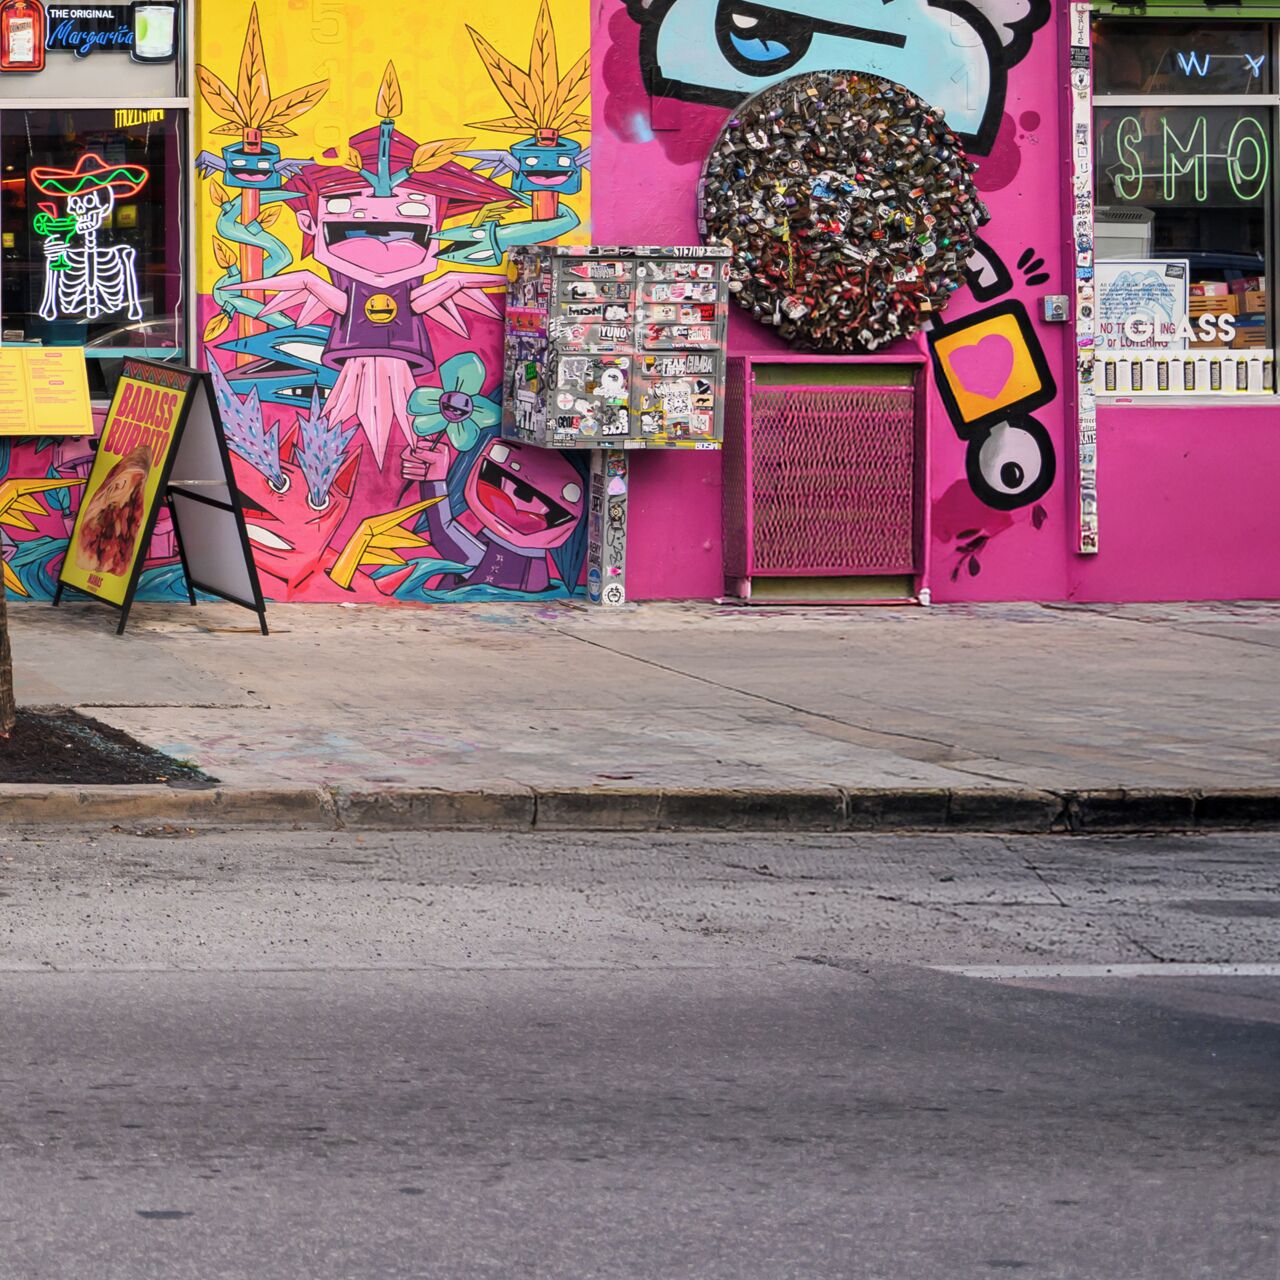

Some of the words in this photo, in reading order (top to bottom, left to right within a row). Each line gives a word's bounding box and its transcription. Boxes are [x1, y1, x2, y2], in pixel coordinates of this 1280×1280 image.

[50, 9, 69, 19] THE
[70, 9, 115, 19] ORIGINAL
[48, 19, 135, 54] Margarita
[1100, 322, 1113, 334] NO
[1107, 338, 1116, 348] or
[1123, 312, 1236, 343] GLASS
[115, 382, 179, 430] BADASS
[103, 417, 170, 468] BURRITO
